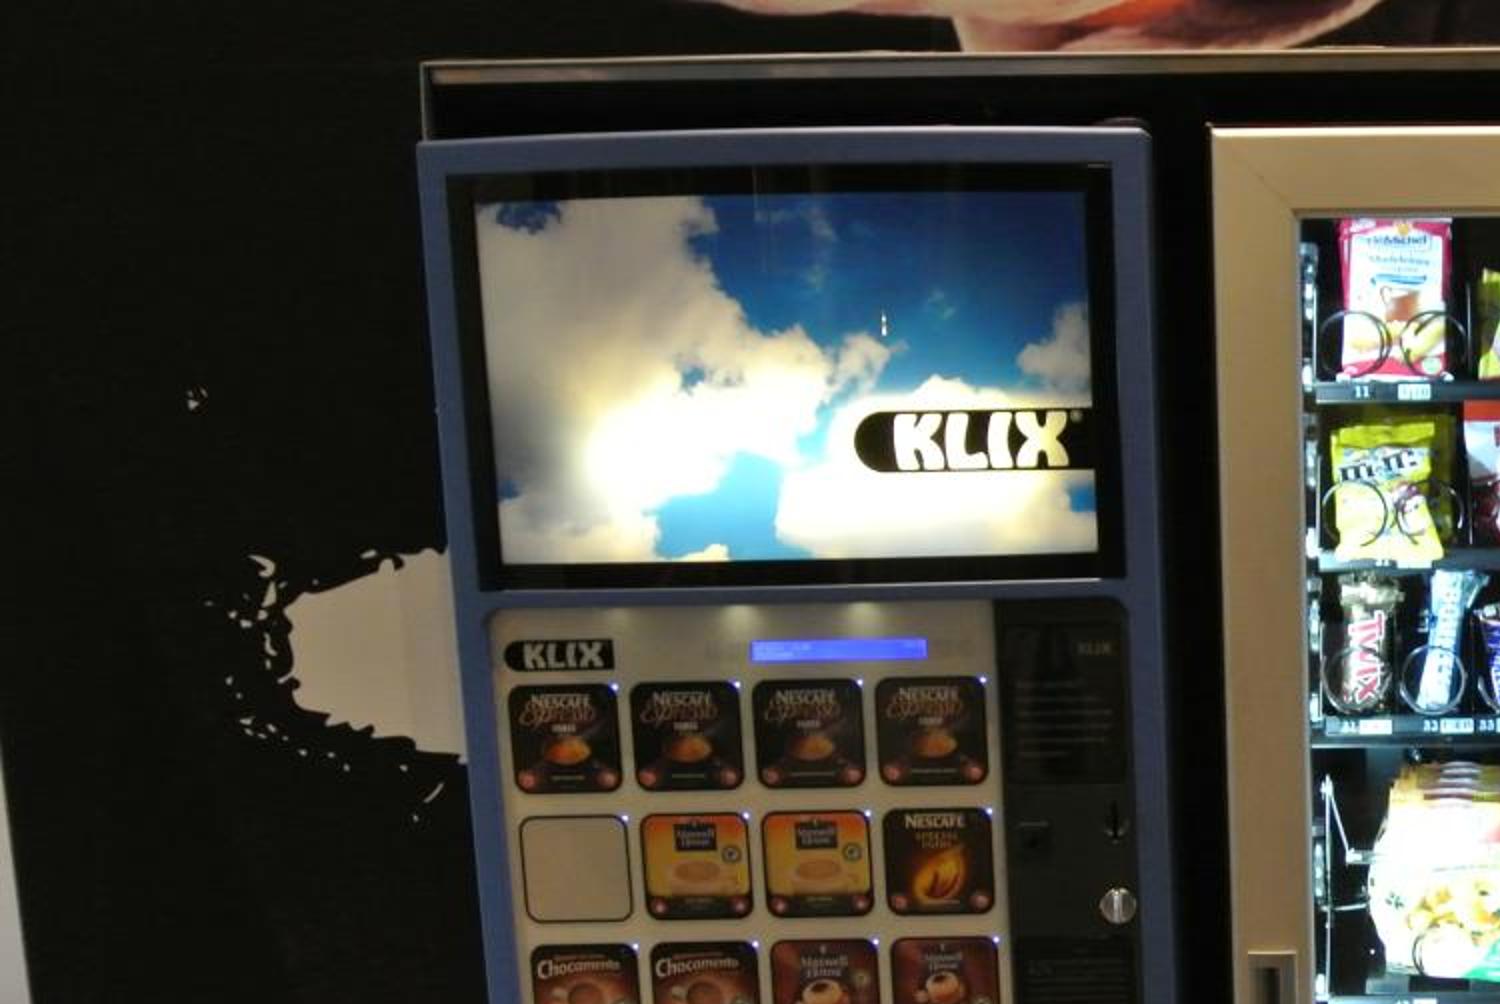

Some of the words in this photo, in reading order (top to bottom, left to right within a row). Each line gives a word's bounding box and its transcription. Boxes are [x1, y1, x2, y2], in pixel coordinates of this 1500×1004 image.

[1354, 385, 1369, 398] 11
[892, 410, 1069, 471] KLIX
[523, 640, 605, 670] KLIX
